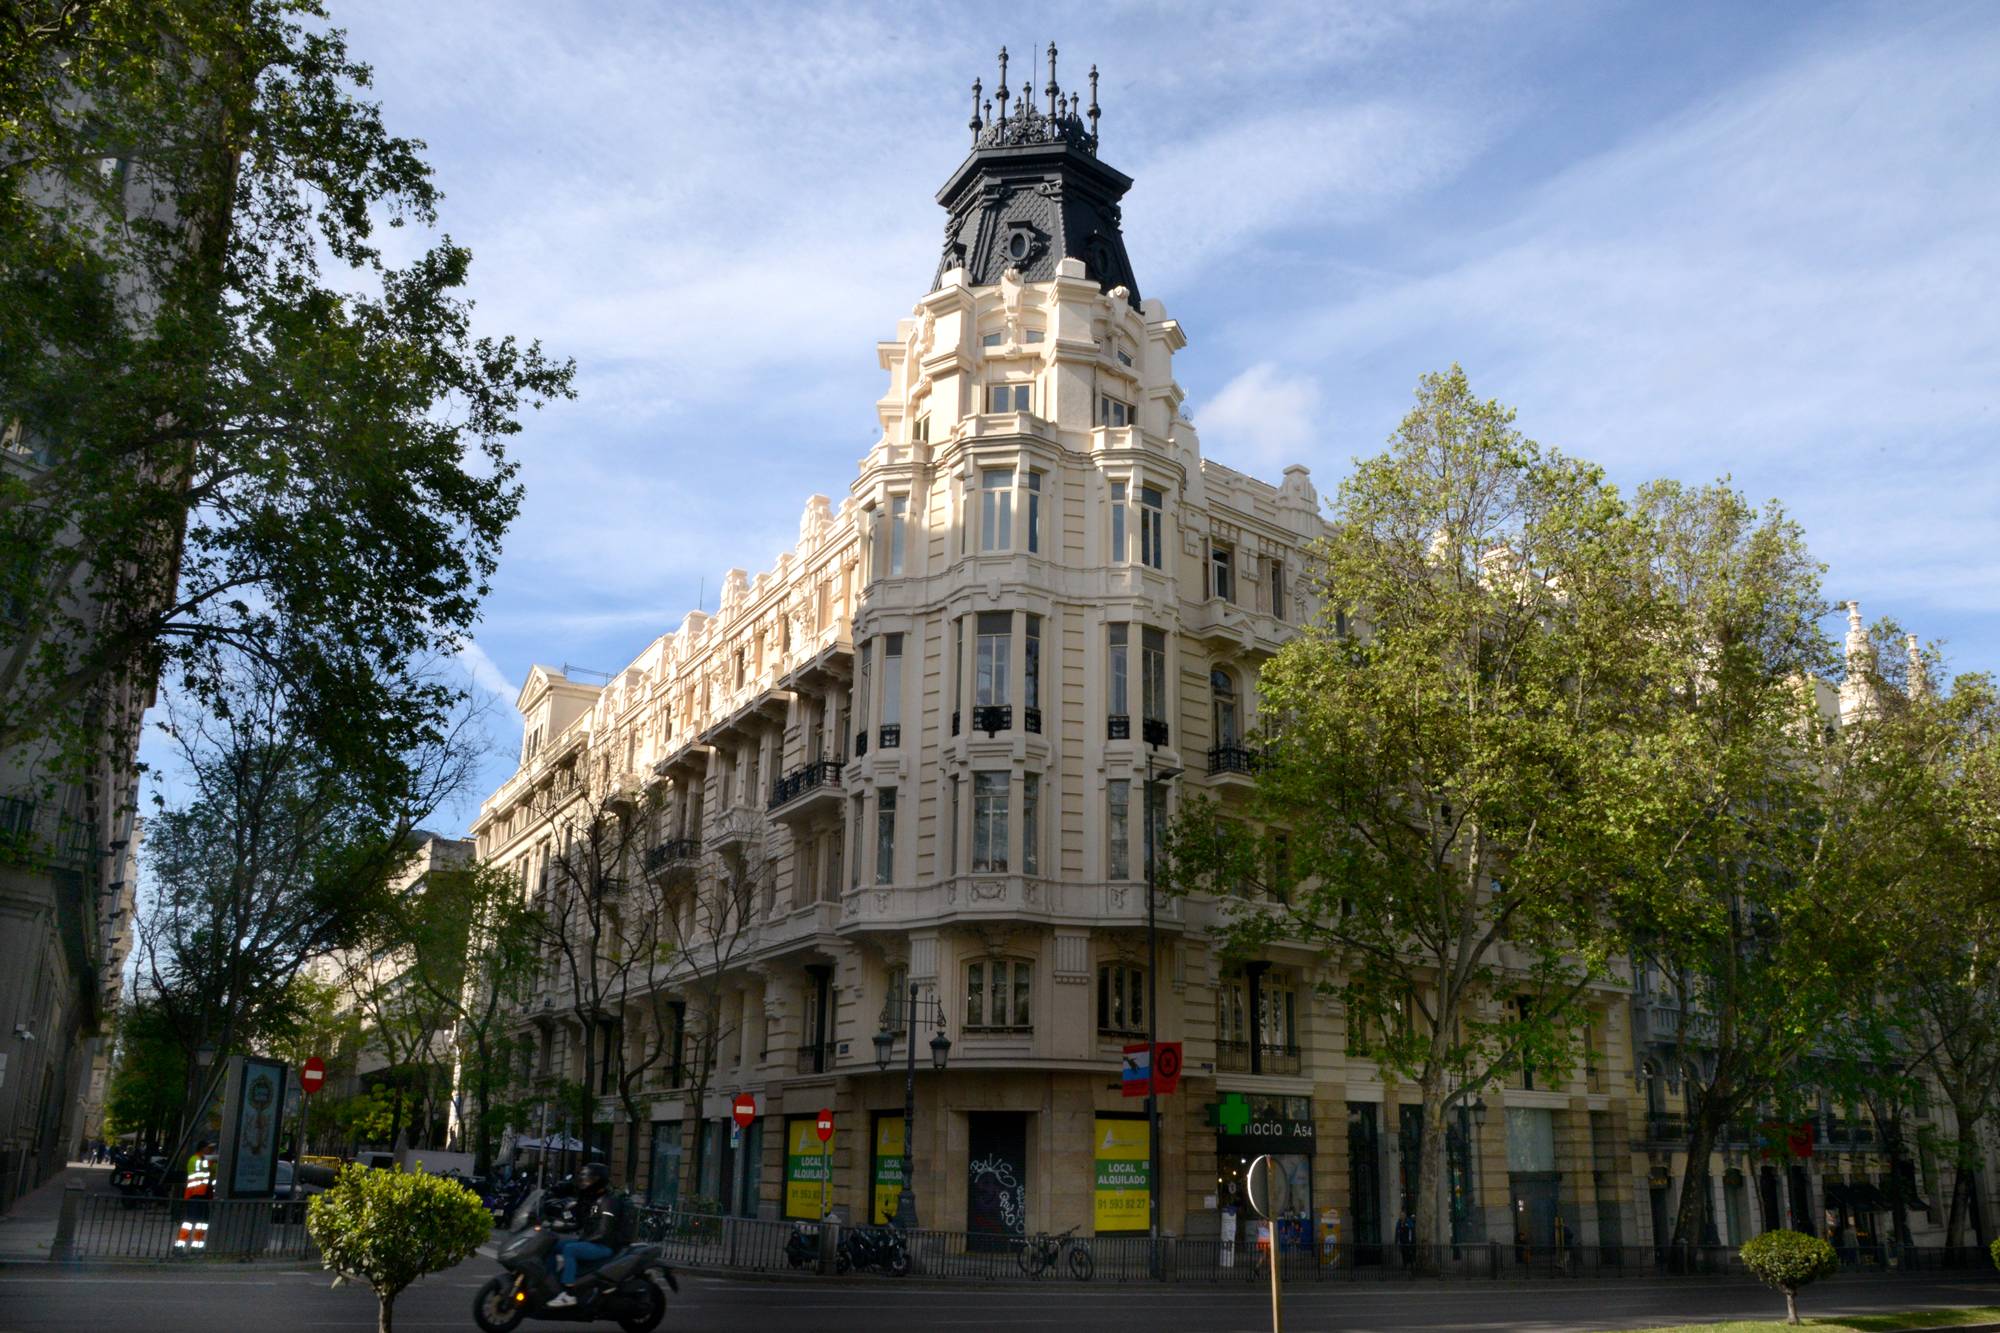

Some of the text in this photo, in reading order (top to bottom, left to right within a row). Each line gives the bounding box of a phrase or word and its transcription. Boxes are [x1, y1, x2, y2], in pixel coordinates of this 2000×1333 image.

[1293, 1122, 1312, 1137] A54
[801, 1156, 822, 1167] LOCAL
[884, 1159, 901, 1168] LOCAL
[1108, 1163, 1136, 1173] LOCAL
[1098, 1175, 1146, 1185] ALQUILADO
